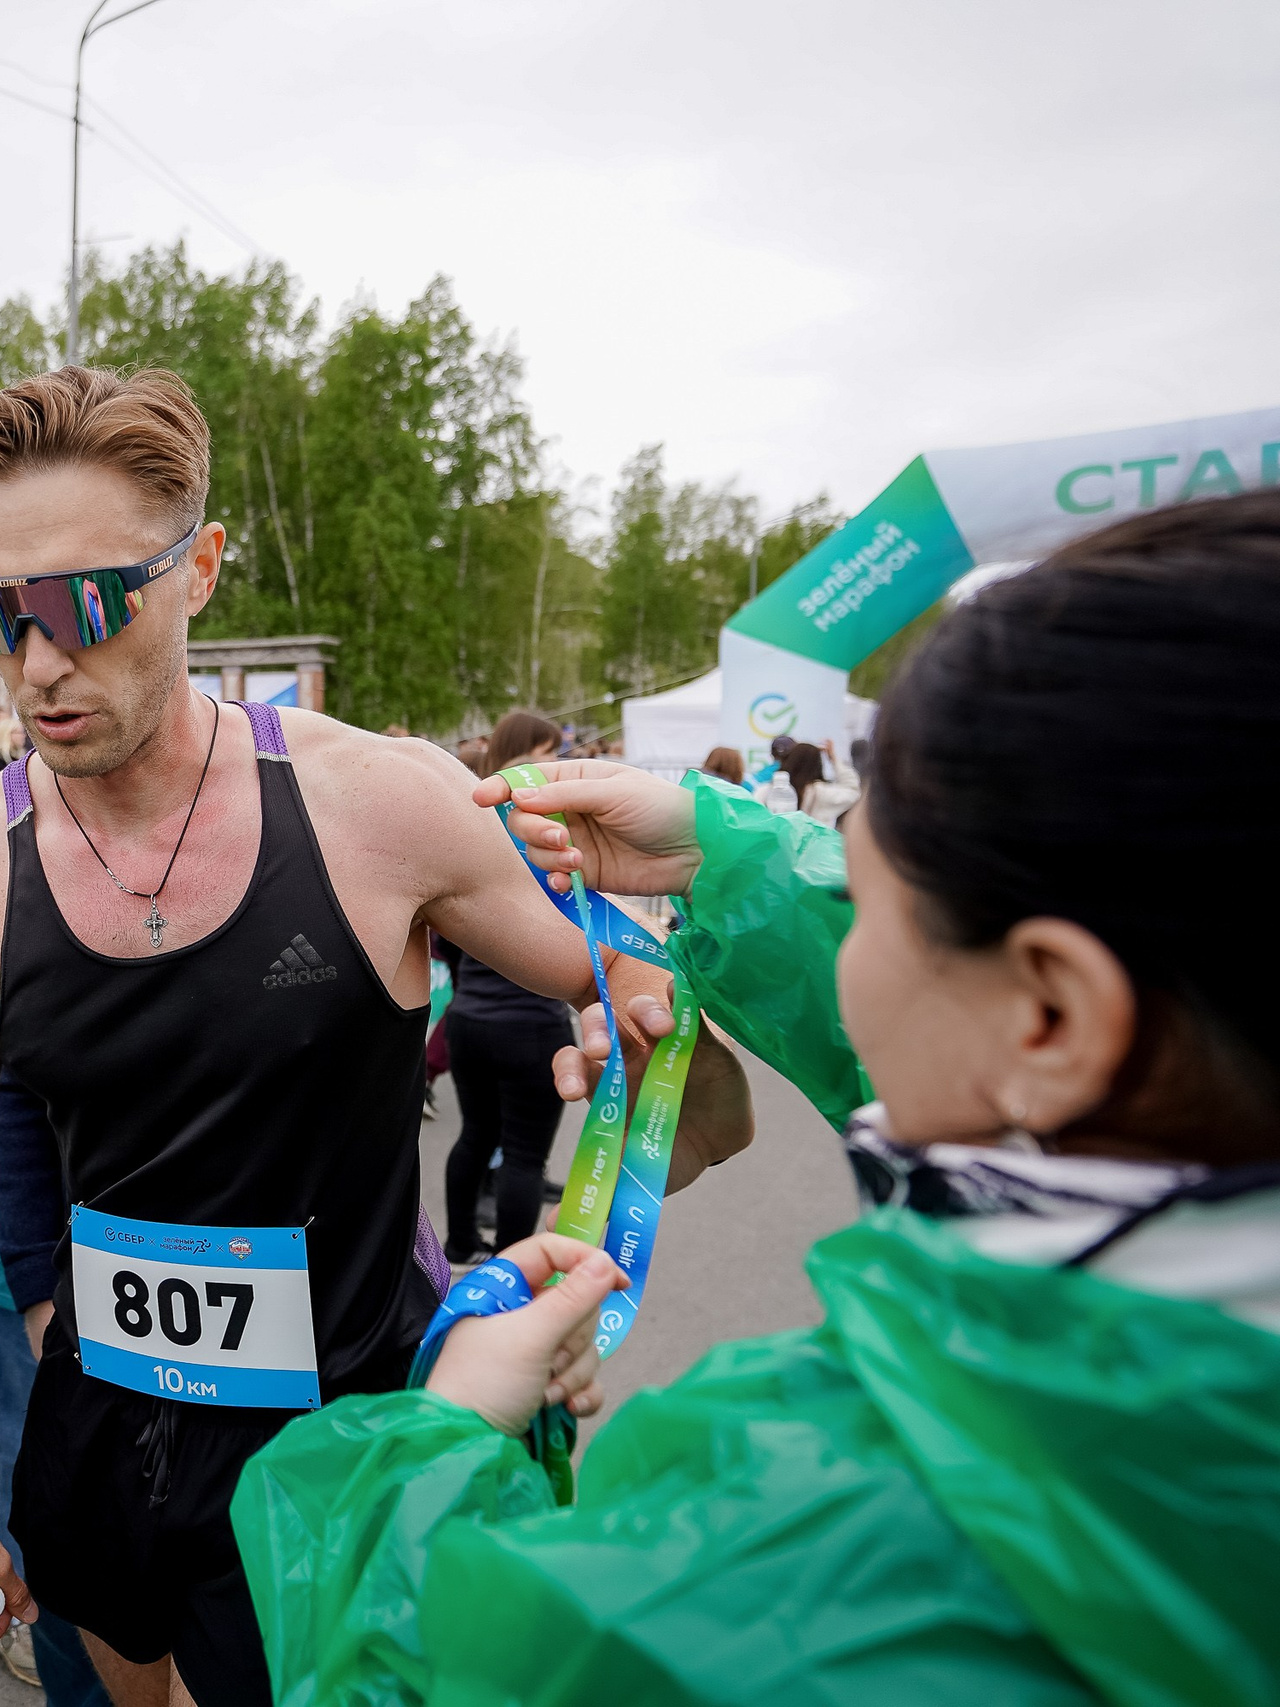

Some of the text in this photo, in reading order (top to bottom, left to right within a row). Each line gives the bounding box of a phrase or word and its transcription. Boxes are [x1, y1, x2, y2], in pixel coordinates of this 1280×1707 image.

[798, 520, 902, 617] зелёный
[814, 538, 920, 632] марафон
[621, 933, 669, 960] СБЕР
[262, 965, 338, 990] adidas
[663, 1005, 692, 1072] 185 лет
[579, 1146, 608, 1216] 185 лет
[117, 1231, 145, 1245] СБЕР
[160, 1243, 193, 1254] марафон
[163, 1236, 195, 1246] зелёный
[618, 1230, 641, 1269] Utair
[477, 1264, 517, 1290] Utair
[112, 1270, 254, 1351] 807
[153, 1365, 184, 1394] 10
